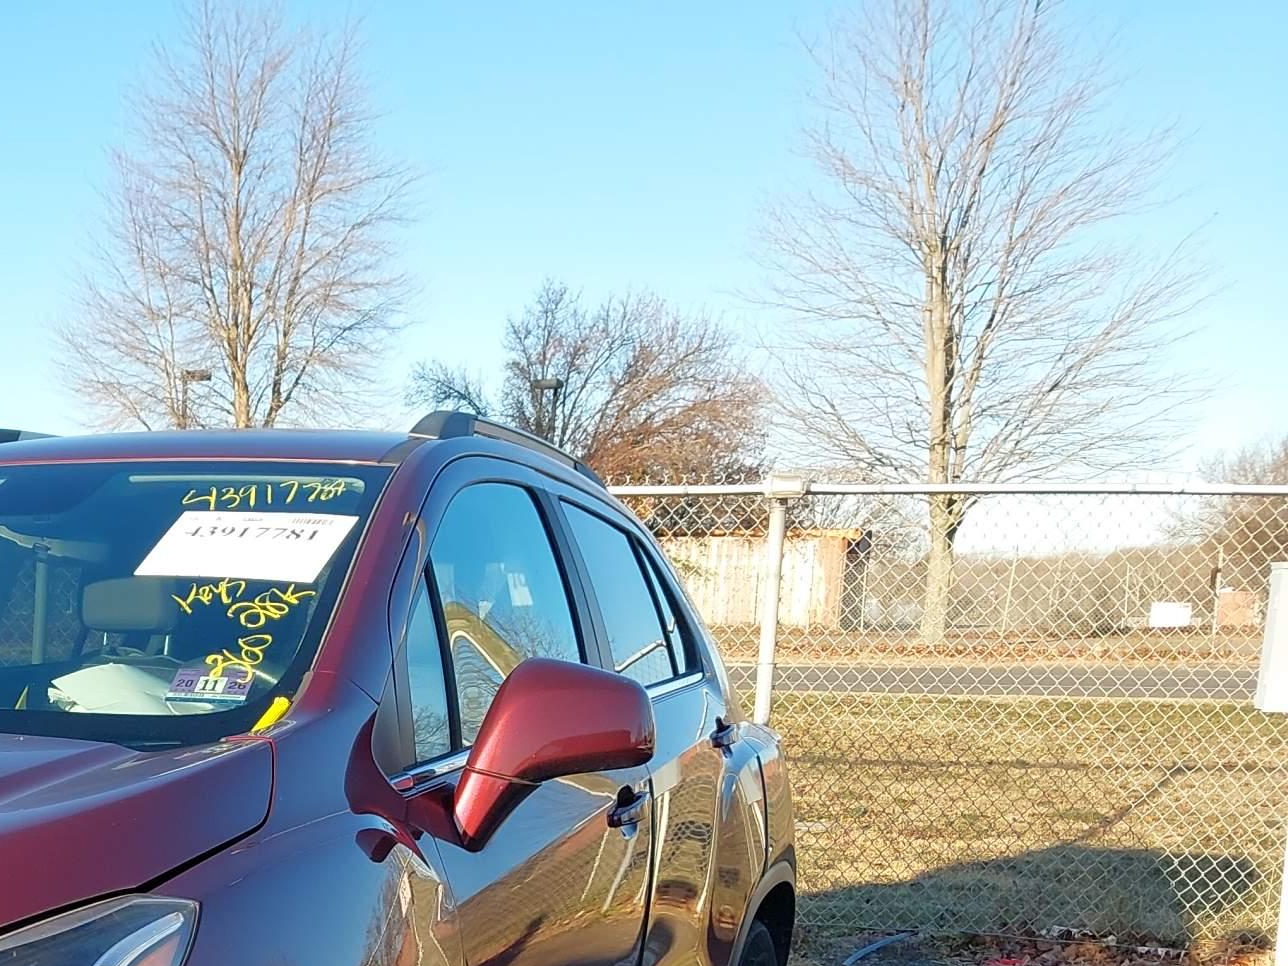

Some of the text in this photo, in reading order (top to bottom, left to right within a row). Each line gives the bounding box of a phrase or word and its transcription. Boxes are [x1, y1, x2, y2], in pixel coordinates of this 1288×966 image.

[185, 525, 319, 540] 43917781
[175, 679, 193, 688] 20
[200, 679, 218, 691] 11
